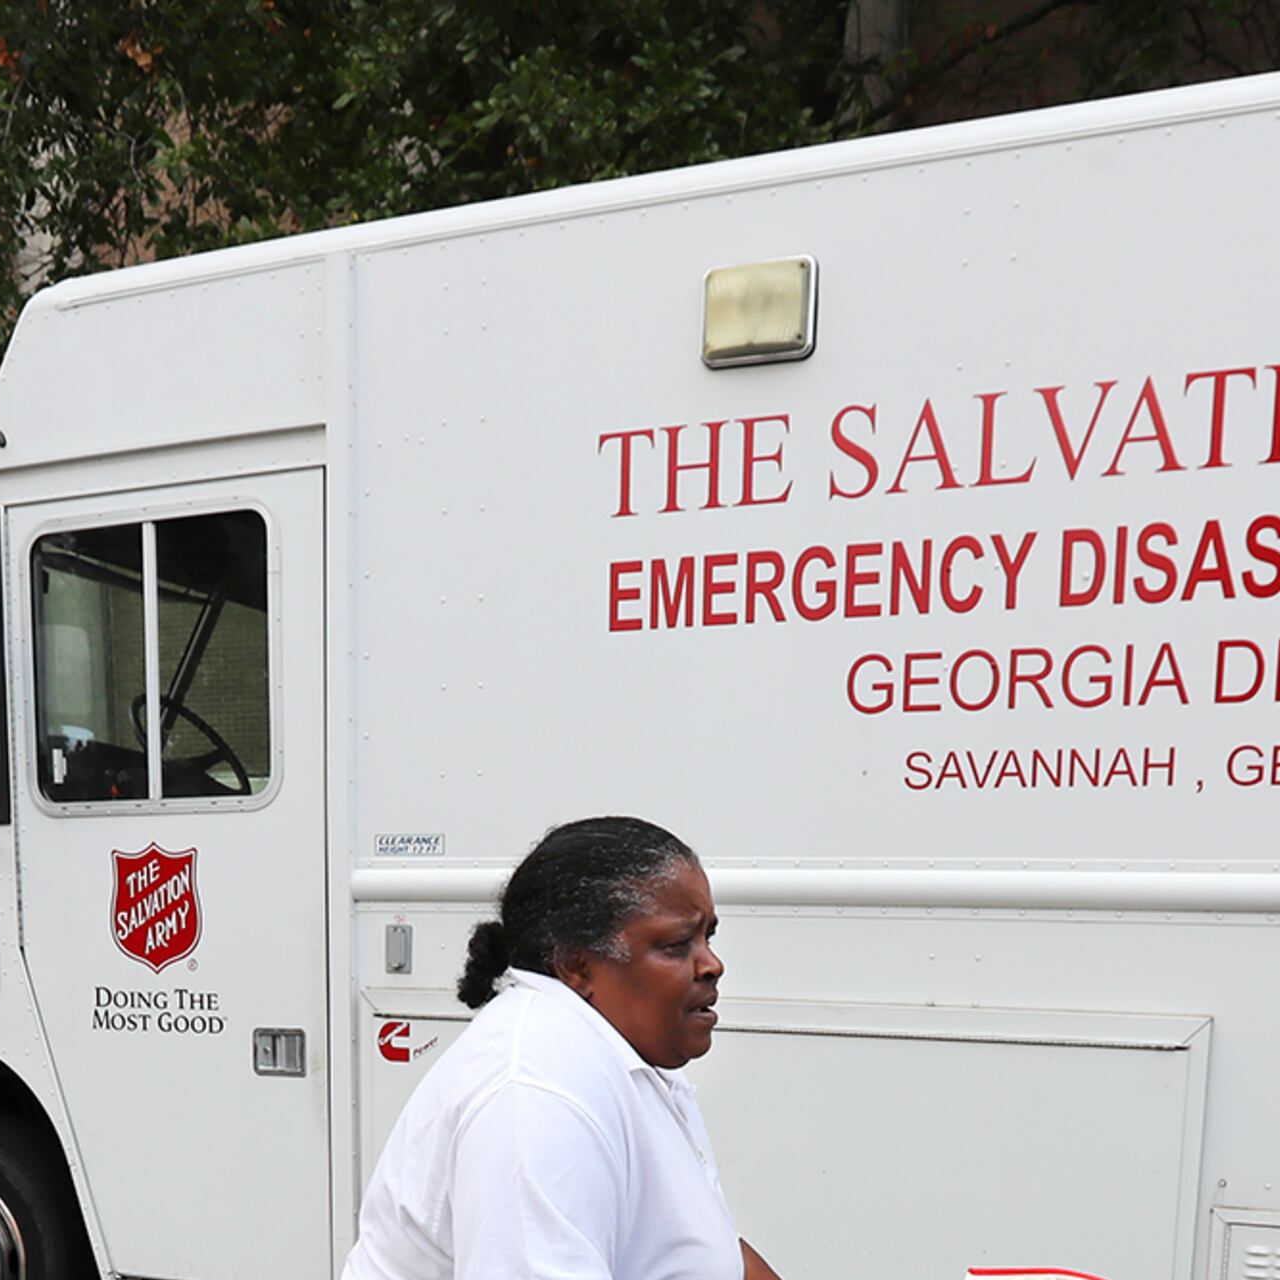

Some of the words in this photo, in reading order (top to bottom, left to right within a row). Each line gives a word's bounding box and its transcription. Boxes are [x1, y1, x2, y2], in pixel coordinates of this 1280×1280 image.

[598, 413, 792, 518] THE
[607, 530, 1038, 633] EMERGENCY
[846, 640, 1190, 716] GEORGIA
[904, 746, 1177, 792] SAVANNAH
[378, 836, 440, 846] CLEARANCE
[117, 863, 191, 940] SALVATION
[125, 859, 161, 898] THE
[144, 899, 190, 955] ARMY
[92, 1008, 153, 1032] MOST
[94, 985, 169, 1010] DOING
[173, 988, 220, 1011] THE
